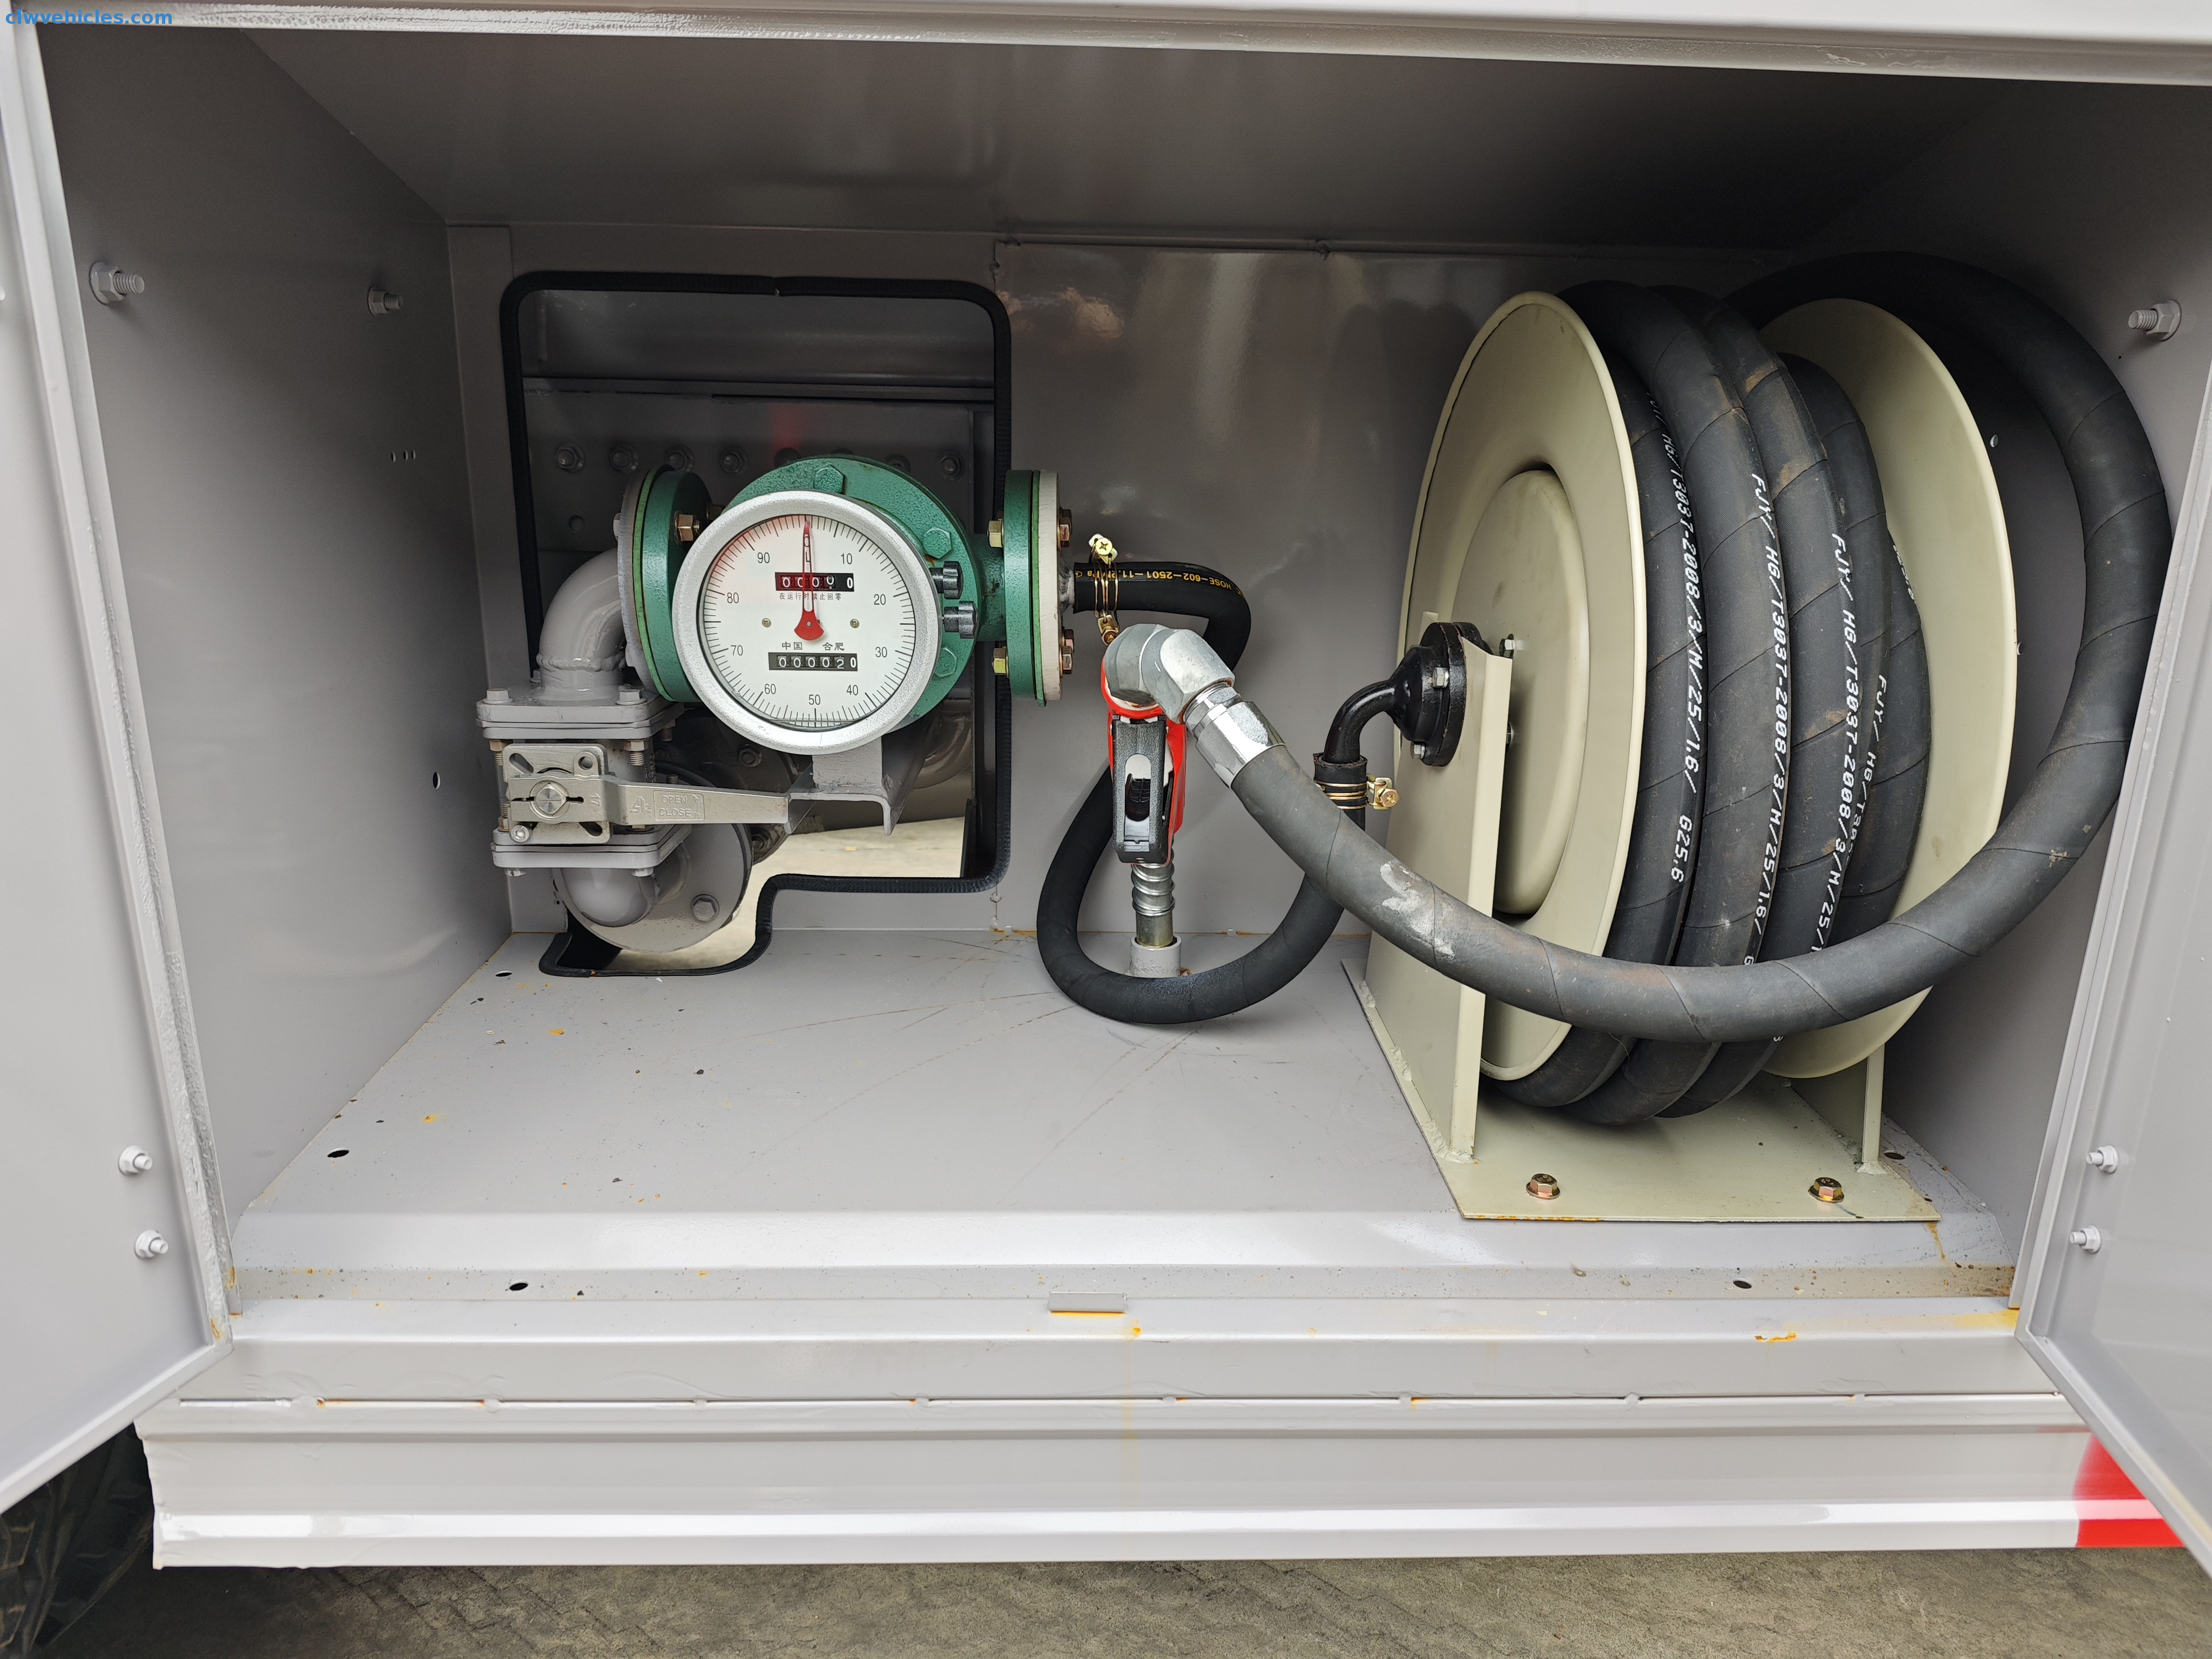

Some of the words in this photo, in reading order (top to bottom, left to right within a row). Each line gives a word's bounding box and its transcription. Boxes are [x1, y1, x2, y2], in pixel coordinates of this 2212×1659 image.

[757, 552, 770, 564] 90
[840, 552, 853, 565] 10
[727, 592, 739, 604] 80
[873, 594, 886, 605] 20
[731, 645, 744, 657] 70
[781, 641, 803, 651] 中国
[822, 642, 845, 651] 合肥
[875, 646, 888, 658] 30
[764, 683, 776, 694] 60
[846, 684, 859, 696] 40
[808, 694, 821, 706] 50
[662, 794, 687, 804] OPEN
[658, 808, 692, 818] CLOSE
[1671, 815, 1692, 882] G25.6
